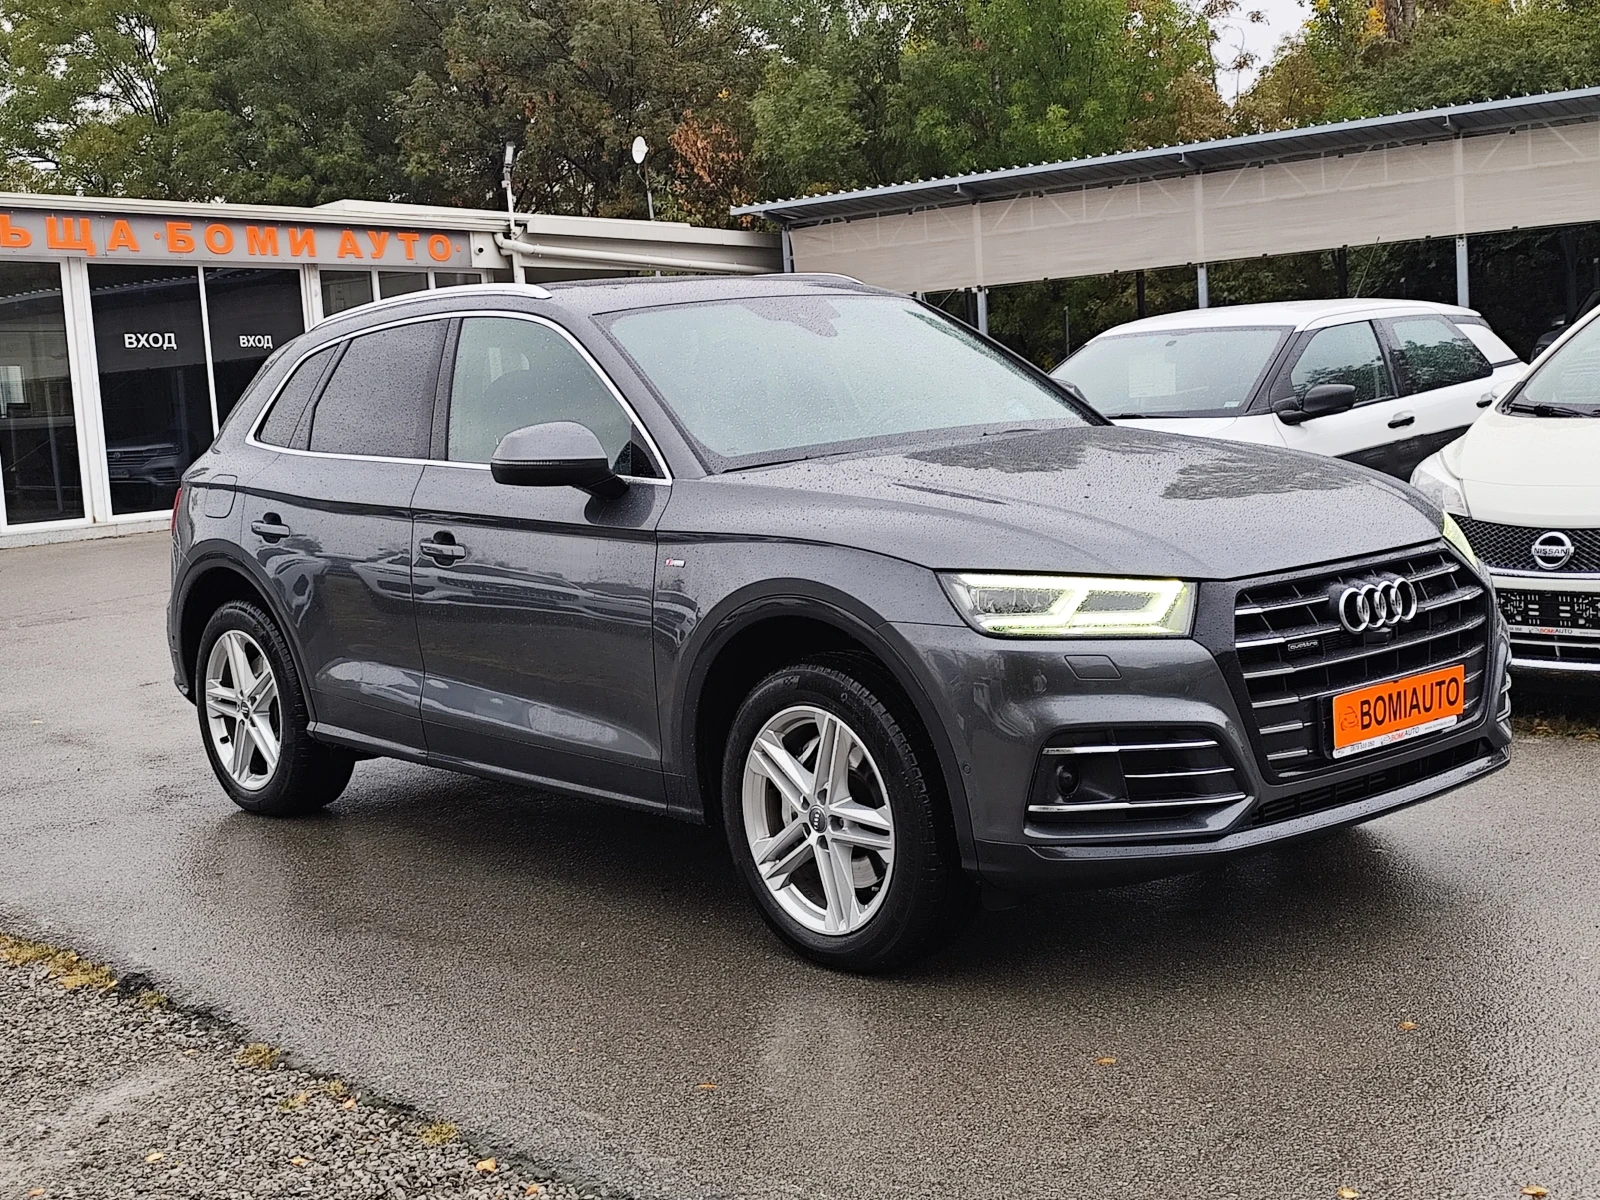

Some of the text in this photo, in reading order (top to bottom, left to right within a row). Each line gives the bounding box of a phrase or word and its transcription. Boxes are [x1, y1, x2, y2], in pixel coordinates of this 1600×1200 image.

[123, 332, 177, 350] ВХОД
[239, 335, 273, 349] ВХОД
[1534, 547, 1570, 556] NISSAN
[1289, 641, 1319, 650] quattro
[1360, 677, 1460, 730] BOMIAUTO
